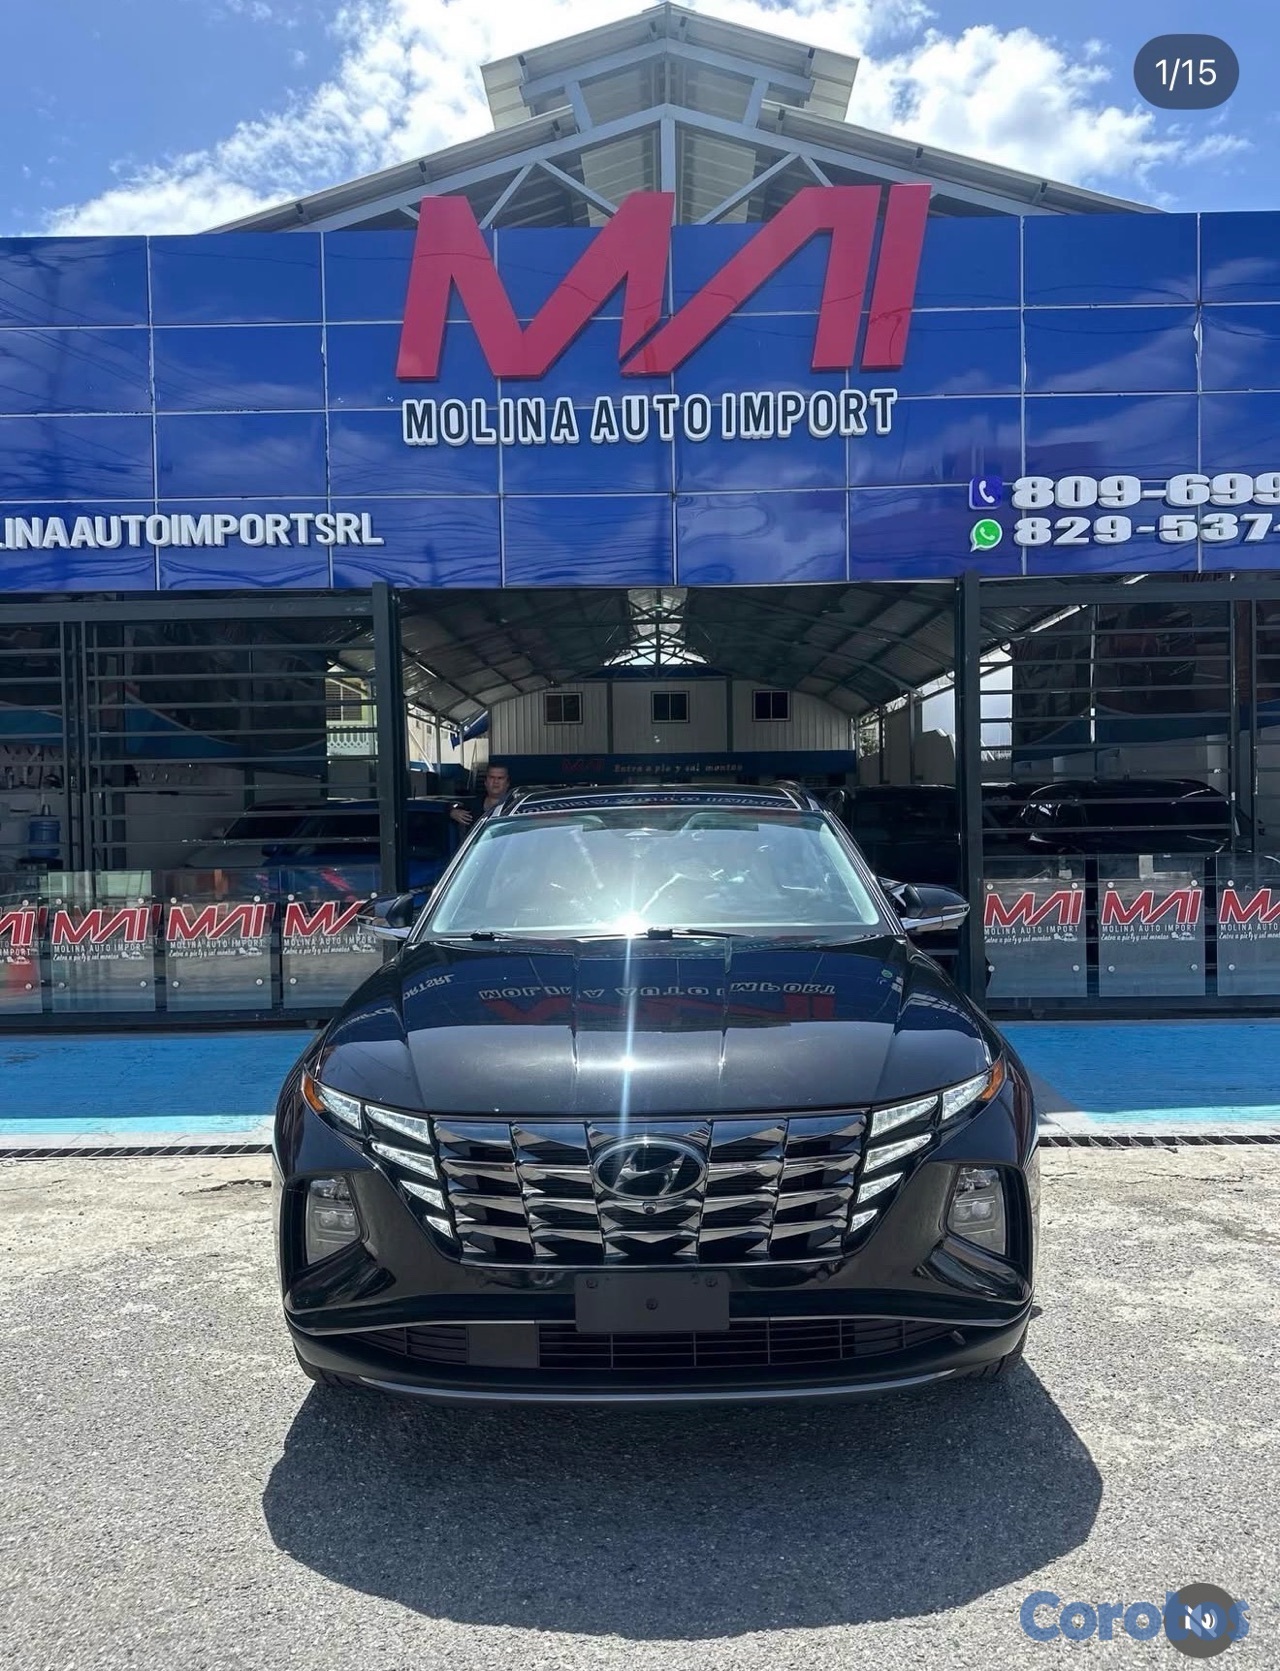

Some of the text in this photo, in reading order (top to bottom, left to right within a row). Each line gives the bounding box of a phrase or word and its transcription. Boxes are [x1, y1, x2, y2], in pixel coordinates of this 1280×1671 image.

[402, 388, 898, 446] MOLINA AUTO IMPORT
[1011, 472, 1280, 509] 809-699
[0, 512, 385, 549] INAAUTOIMPORTSRL
[1013, 512, 1280, 546] 829-537
[984, 925, 1079, 936] MOLINA AUTO IMPORT
[1102, 924, 1197, 933] MOLINA AUTO IMPORT
[1220, 923, 1278, 932] MOLINA AUTO
[170, 939, 264, 949] MOLINA AUTO IMPORT
[283, 938, 316, 947] MOLINA
[53, 944, 86, 953] MOLINA
[89, 944, 111, 952] AUTO
[114, 943, 147, 952] IMPORT
